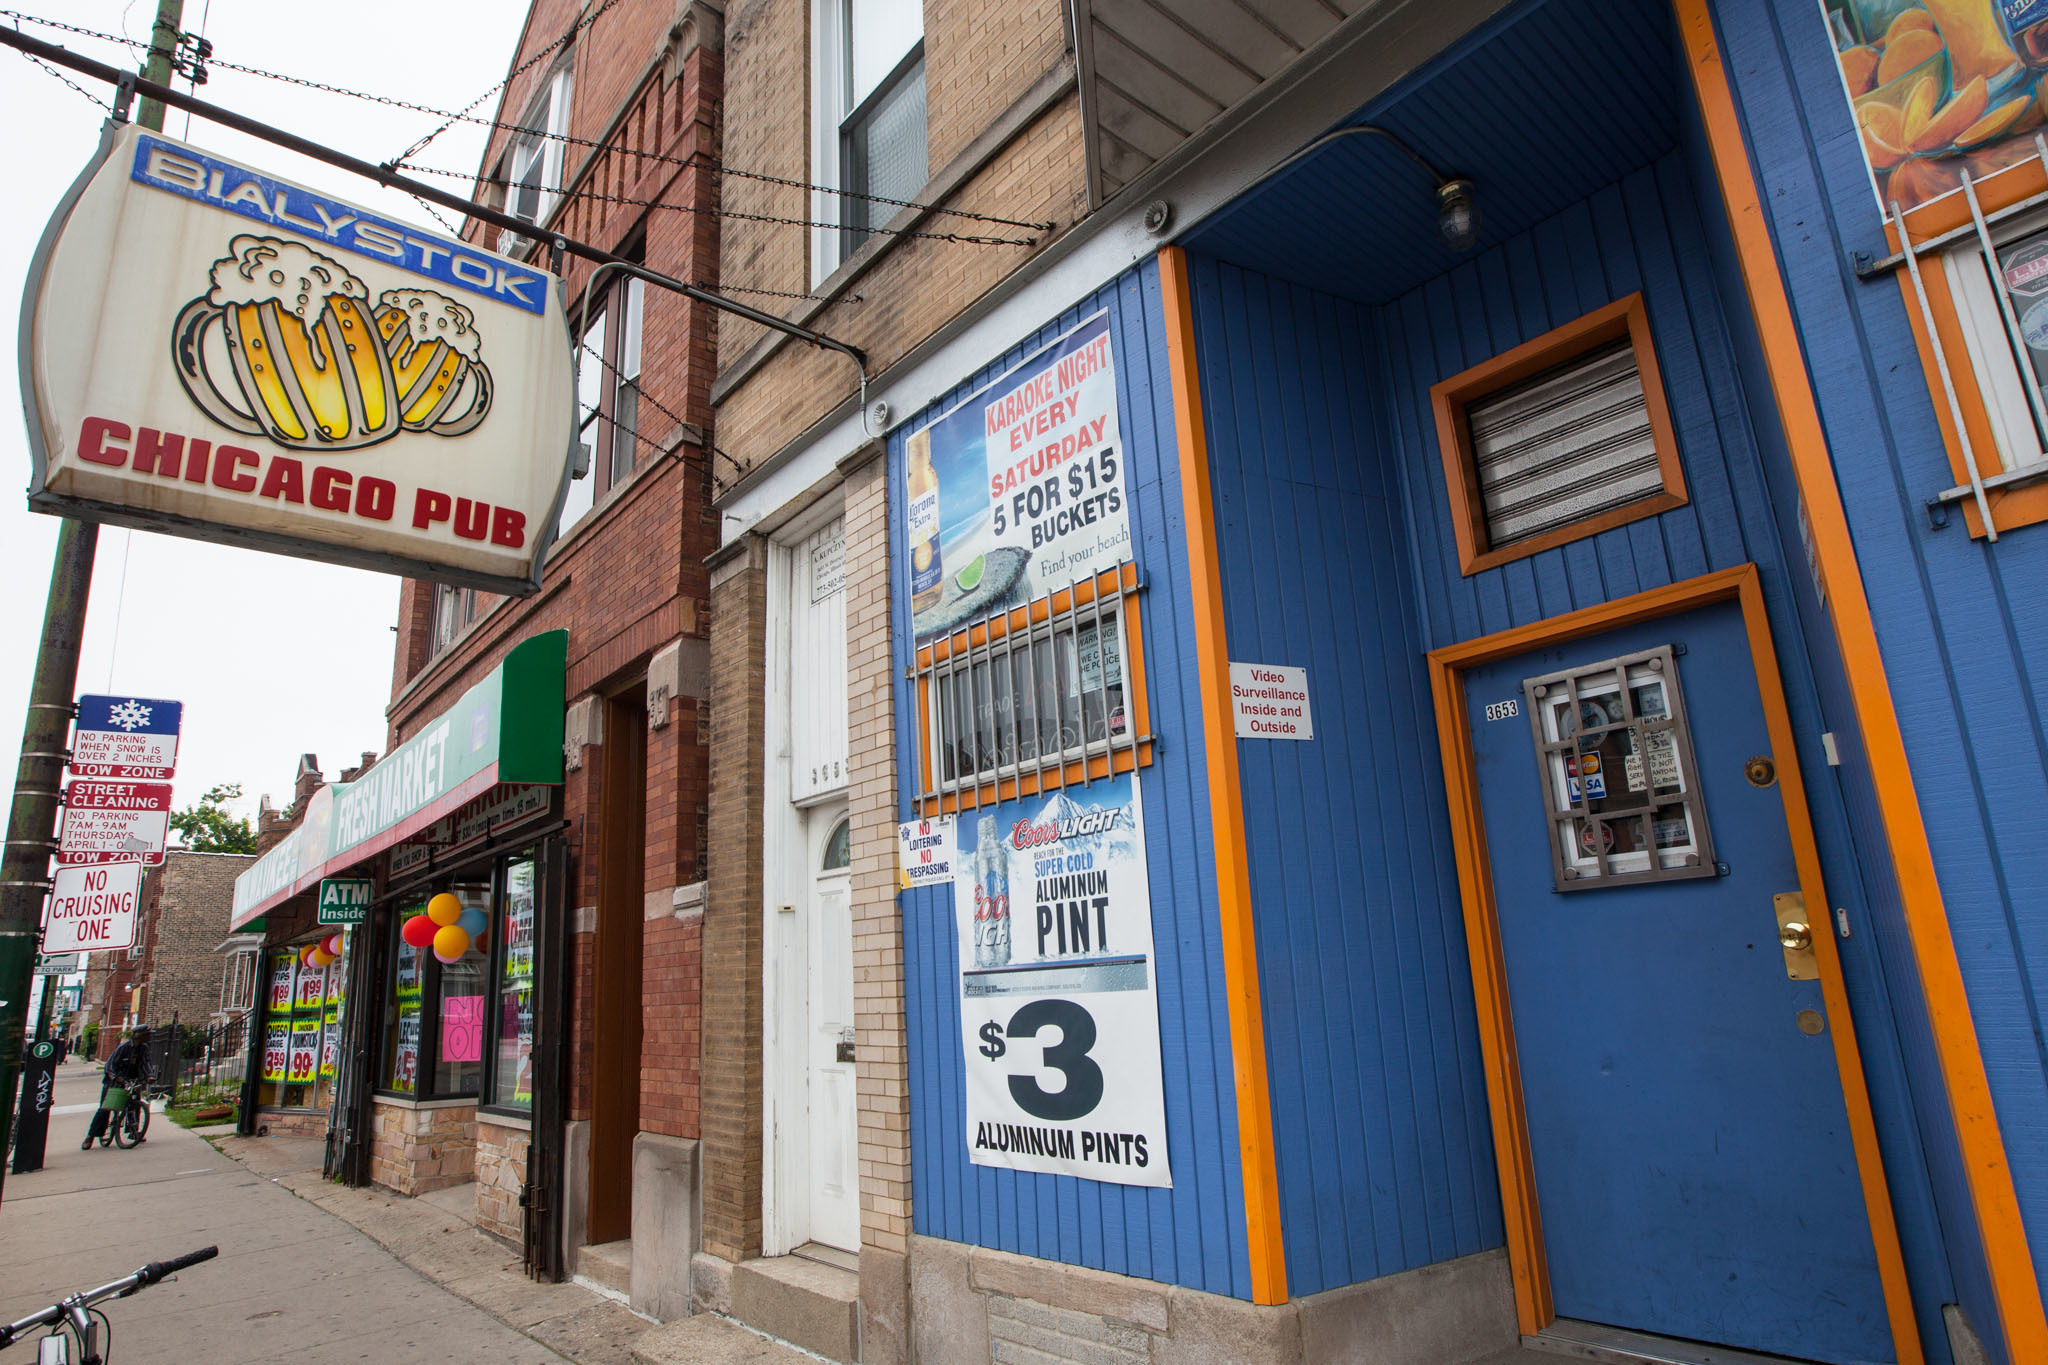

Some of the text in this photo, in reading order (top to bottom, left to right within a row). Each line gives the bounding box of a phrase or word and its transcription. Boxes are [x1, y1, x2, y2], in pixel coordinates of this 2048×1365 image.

[142, 147, 536, 306] BIALYSTOK
[986, 335, 1107, 437] KARAOKE NIGHT
[1010, 390, 1079, 452] EVERY
[991, 414, 1107, 498] SATURDAY
[77, 416, 526, 549] CHICAGO PUB
[993, 446, 1117, 536] 5 FOR $15
[910, 494, 935, 521] Corona
[914, 513, 931, 529] Extra
[1031, 486, 1121, 549] BUCKETS
[1041, 524, 1129, 577] Find your beach
[1080, 628, 1116, 647] WARNNG!
[1081, 647, 1114, 664] WE CLL
[1079, 663, 1091, 673] HE
[1251, 669, 1285, 683] Video
[1233, 685, 1306, 701] Surveillance
[1241, 702, 1302, 717] Inside and
[1487, 701, 1517, 720] 3653
[1250, 720, 1296, 734] Outside
[81, 732, 147, 744] NO PARKING
[80, 742, 161, 755] WHEN SNOW IS
[78, 752, 162, 763] OVER 2 INCHES
[77, 764, 166, 778] TOW ZONE
[1627, 764, 1642, 772] RIGH
[1629, 772, 1644, 780] SERV
[74, 783, 137, 796] STREET
[336, 774, 380, 852] FRESH
[380, 720, 450, 828] MARKET
[1572, 778, 1602, 791] VSA
[72, 795, 159, 808] CLEANING
[69, 812, 139, 821] NO PARKING
[67, 831, 134, 840] THURSDAYS
[919, 821, 930, 836] NO
[1012, 807, 1121, 851] Coors LIGHT
[65, 841, 98, 849] APRIL
[909, 834, 942, 851] LOITERING
[64, 852, 155, 864] TOW ZONE
[920, 848, 932, 864] NO
[1033, 846, 1064, 860] REACH FOR THE
[906, 861, 949, 878] TRESPASSING
[1034, 851, 1093, 878] SUPER COLD
[84, 870, 108, 892] NO
[1036, 869, 1108, 903] ALUMINUM
[323, 883, 370, 905] ATM
[53, 892, 133, 919] CRUISING
[322, 906, 366, 920] Inside
[69, 919, 112, 942] ONE
[1036, 896, 1109, 956] PINT
[267, 1024, 288, 1040] QUESO
[39, 1045, 49, 1056] P
[978, 999, 1104, 1122] $3
[975, 1121, 1149, 1168] ALUMINUM PINTS
